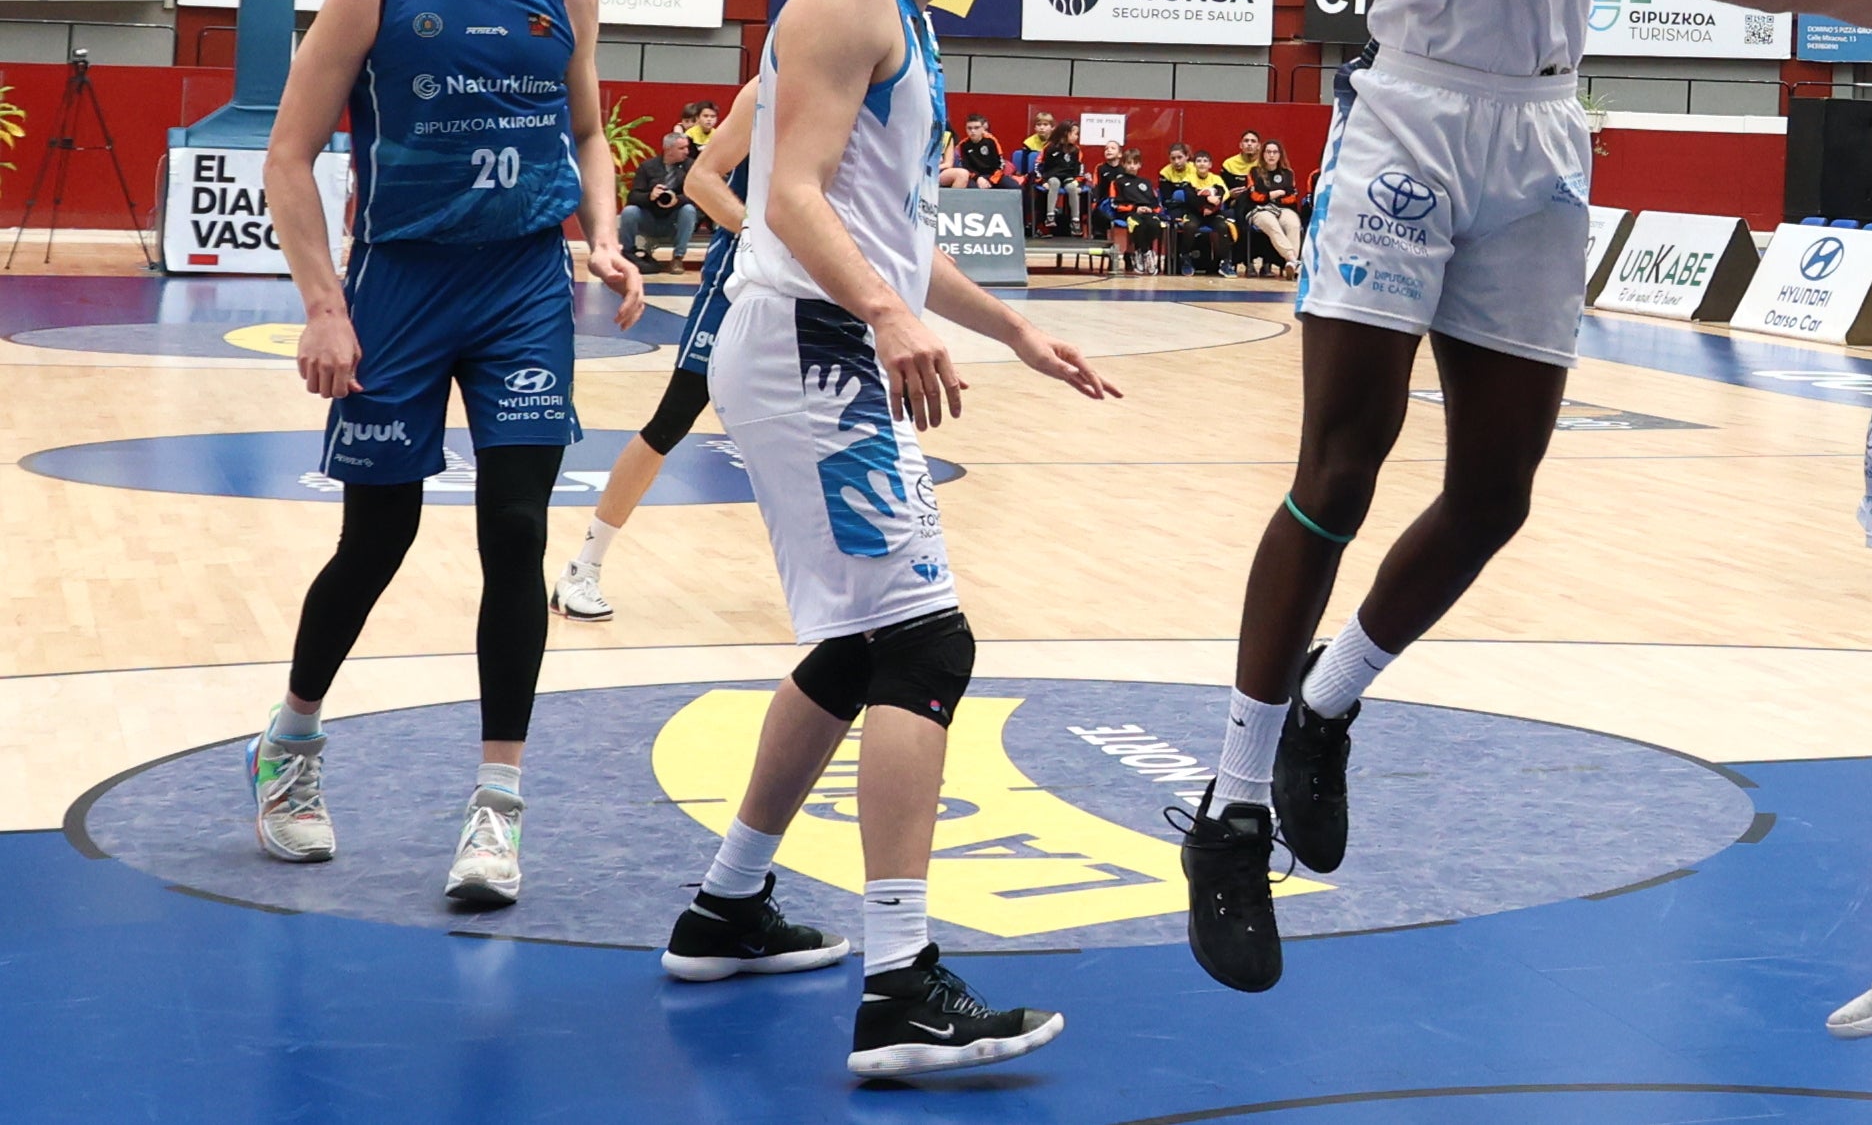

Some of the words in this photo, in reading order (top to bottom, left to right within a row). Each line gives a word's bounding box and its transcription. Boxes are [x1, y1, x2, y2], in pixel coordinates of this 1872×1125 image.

[1112, 7, 1180, 20] SEGUROS
[1184, 9, 1203, 21] DE
[1207, 10, 1255, 22] SALUD
[1629, 10, 1716, 26] GIPUZKOA
[1629, 27, 1713, 43] TURISMOA
[498, 113, 557, 129] KIROLAK
[194, 154, 236, 183] EL
[471, 146, 520, 189] 20
[191, 187, 268, 216] DIA
[192, 220, 282, 250] VASC
[938, 212, 1013, 239] NSA
[1357, 214, 1428, 246] TOYOTA
[938, 242, 960, 256] DE
[963, 243, 1014, 256] SALUD
[1353, 231, 1430, 257] NOVOMOTOR
[1619, 244, 1714, 287] URKABE
[1777, 285, 1832, 308] HYUNDAI
[1764, 310, 1797, 328] Oarso
[1800, 314, 1823, 332] Car
[498, 395, 563, 408] HYUNDAI
[496, 410, 540, 422] Oarso
[544, 409, 565, 420] Car
[341, 420, 412, 447] guuk.
[1066, 724, 1218, 783] NORTE
